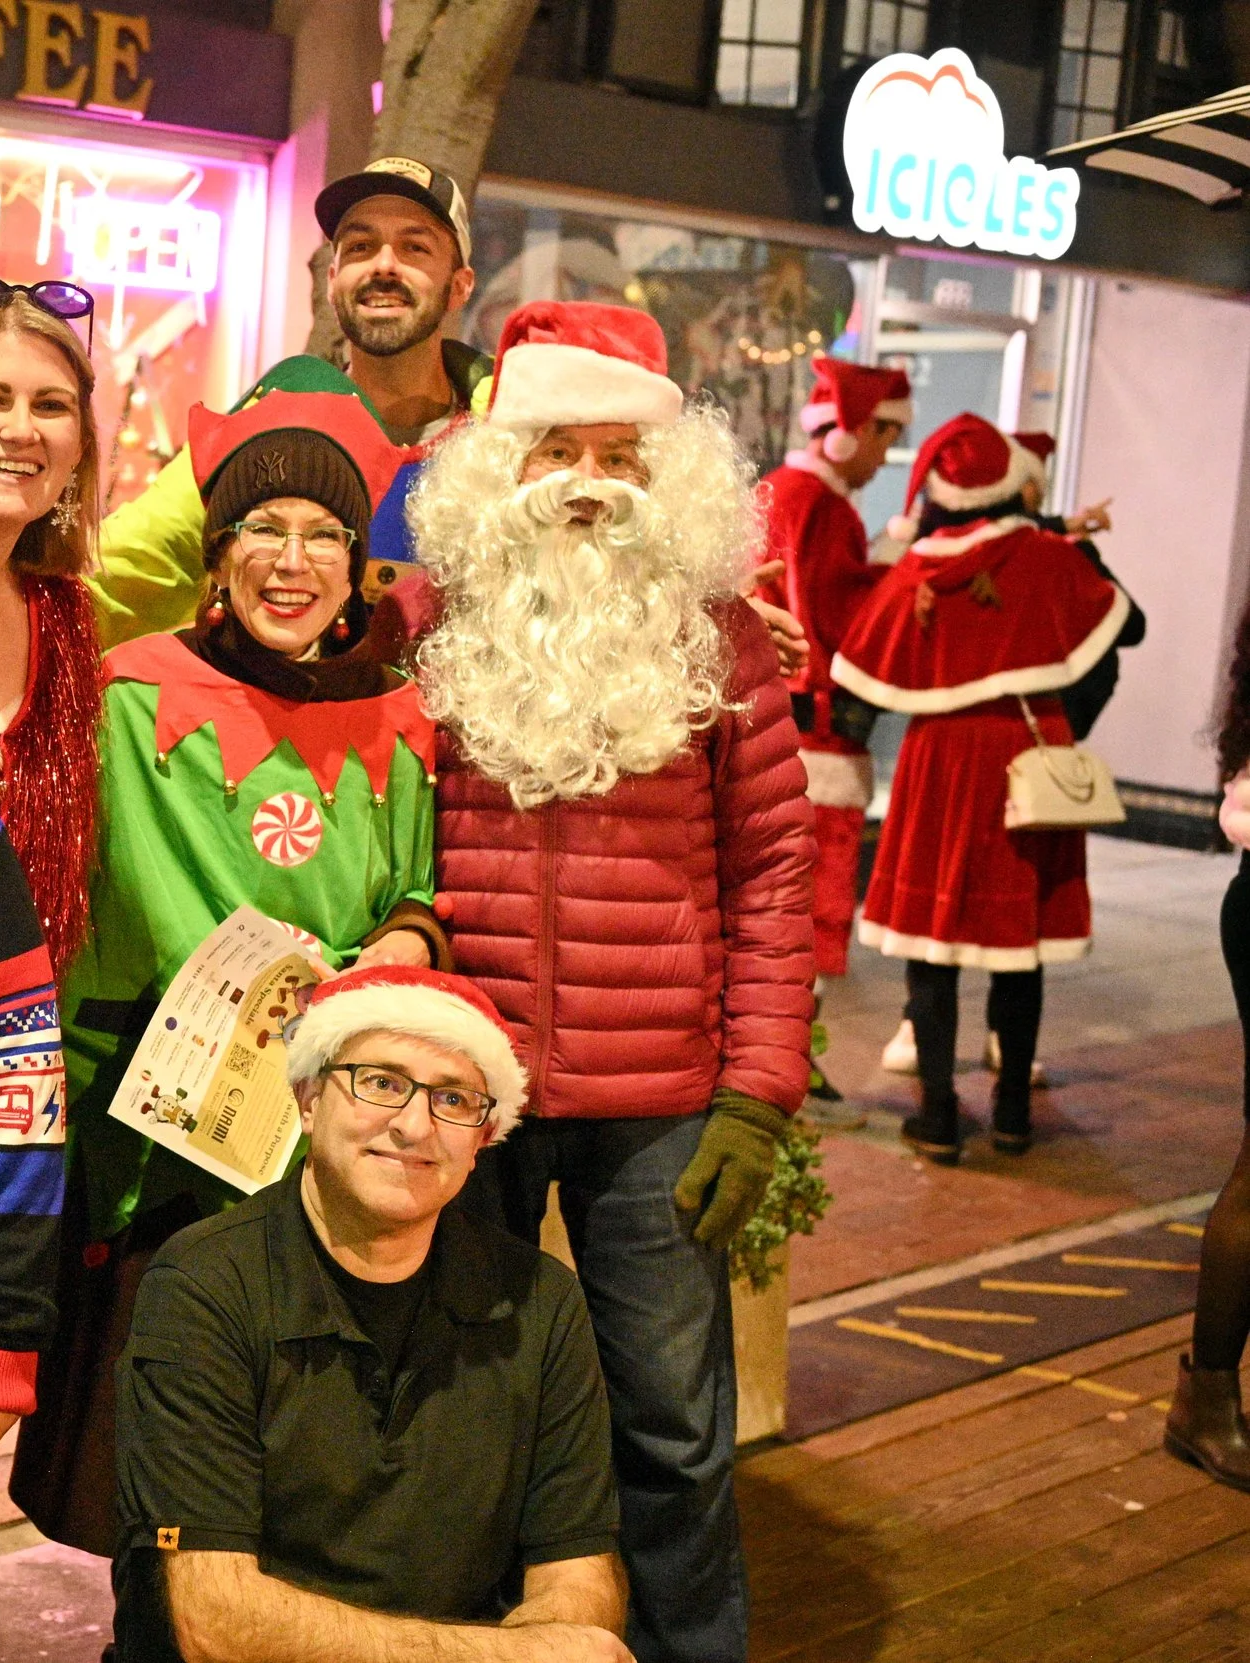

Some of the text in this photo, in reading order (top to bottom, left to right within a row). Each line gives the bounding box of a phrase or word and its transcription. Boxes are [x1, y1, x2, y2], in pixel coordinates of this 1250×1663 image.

[82, 208, 214, 286] OPEN
[254, 448, 287, 490] NY
[268, 964, 293, 987] Santa
[245, 988, 272, 1026] Specials
[210, 1105, 238, 1144] NAMI
[280, 1104, 293, 1126] with
[258, 1134, 281, 1176] Purpose
